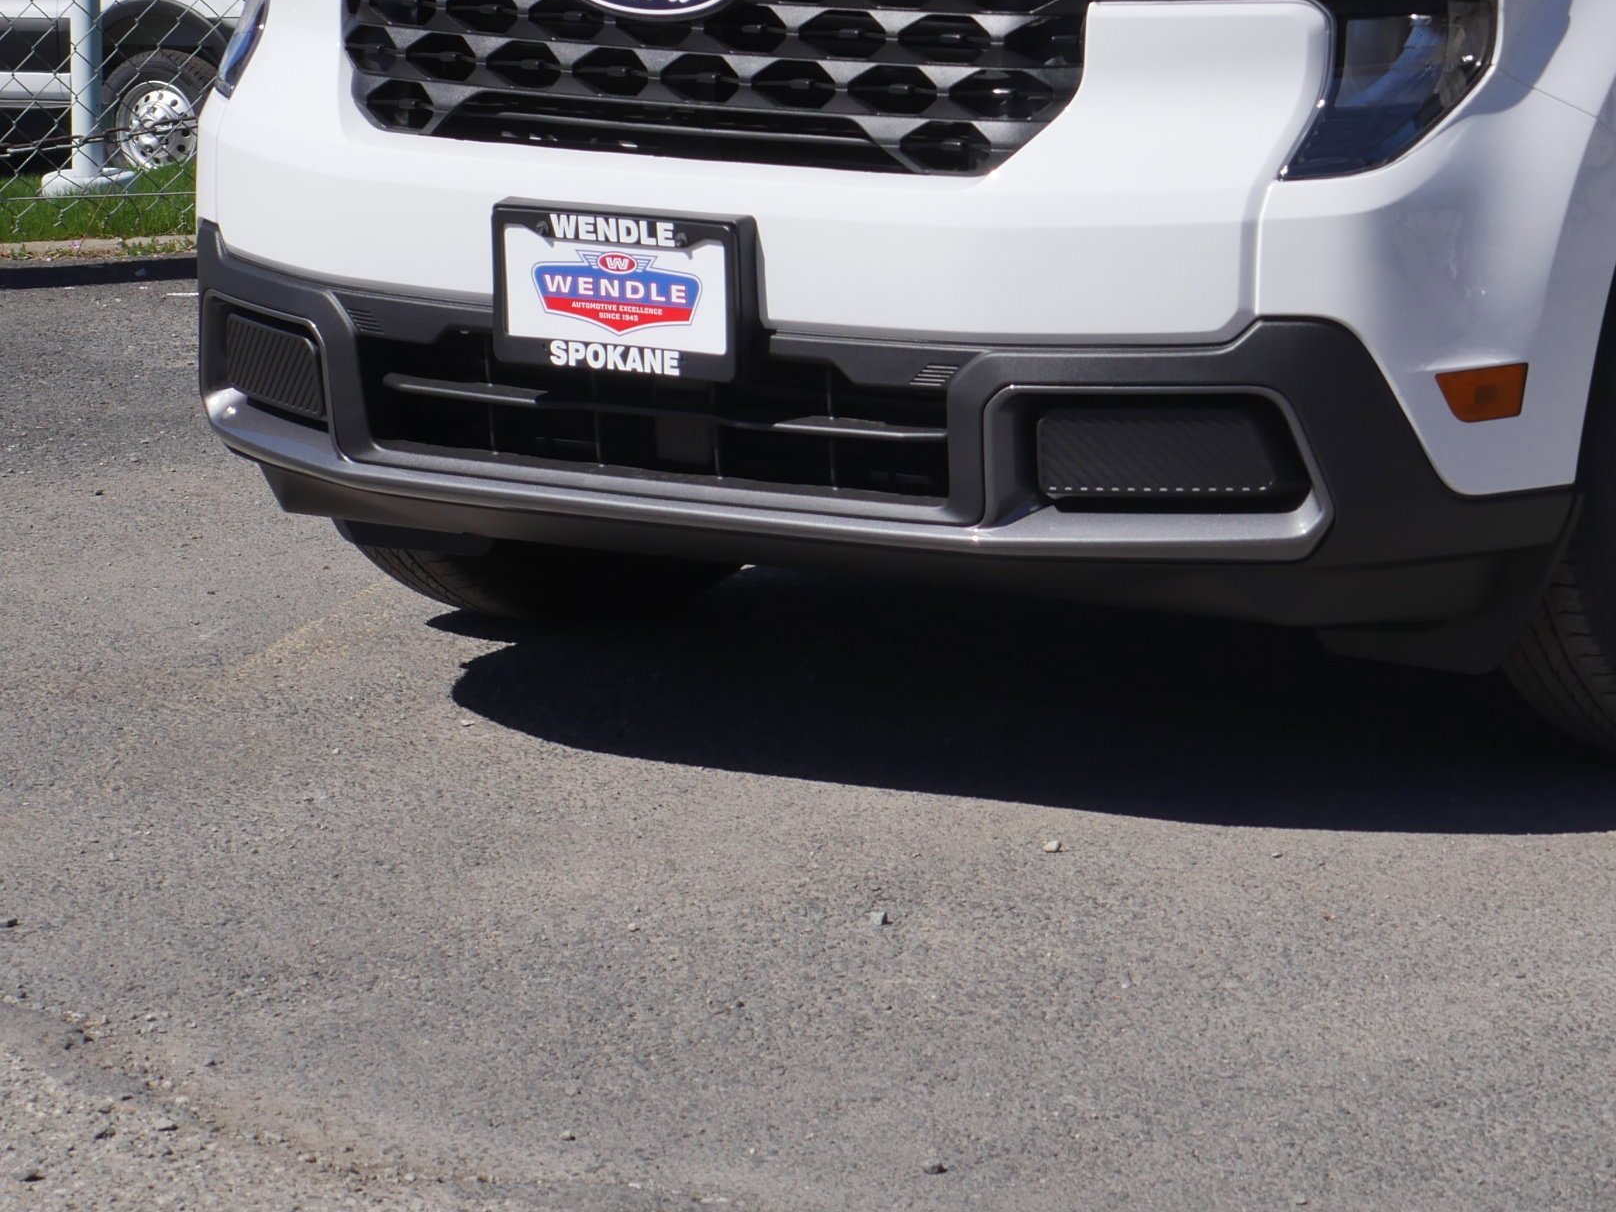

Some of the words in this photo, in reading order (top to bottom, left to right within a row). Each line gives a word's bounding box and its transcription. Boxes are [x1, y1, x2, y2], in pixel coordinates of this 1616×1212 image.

[549, 213, 676, 247] WENDLE
[544, 274, 687, 303] WENDLE
[571, 301, 617, 312] AUTOMOTIVE
[618, 304, 663, 316] EXCELLENCE
[598, 311, 621, 321] SINCE
[621, 313, 639, 322] 1943
[549, 339, 680, 377] SPOKANE
